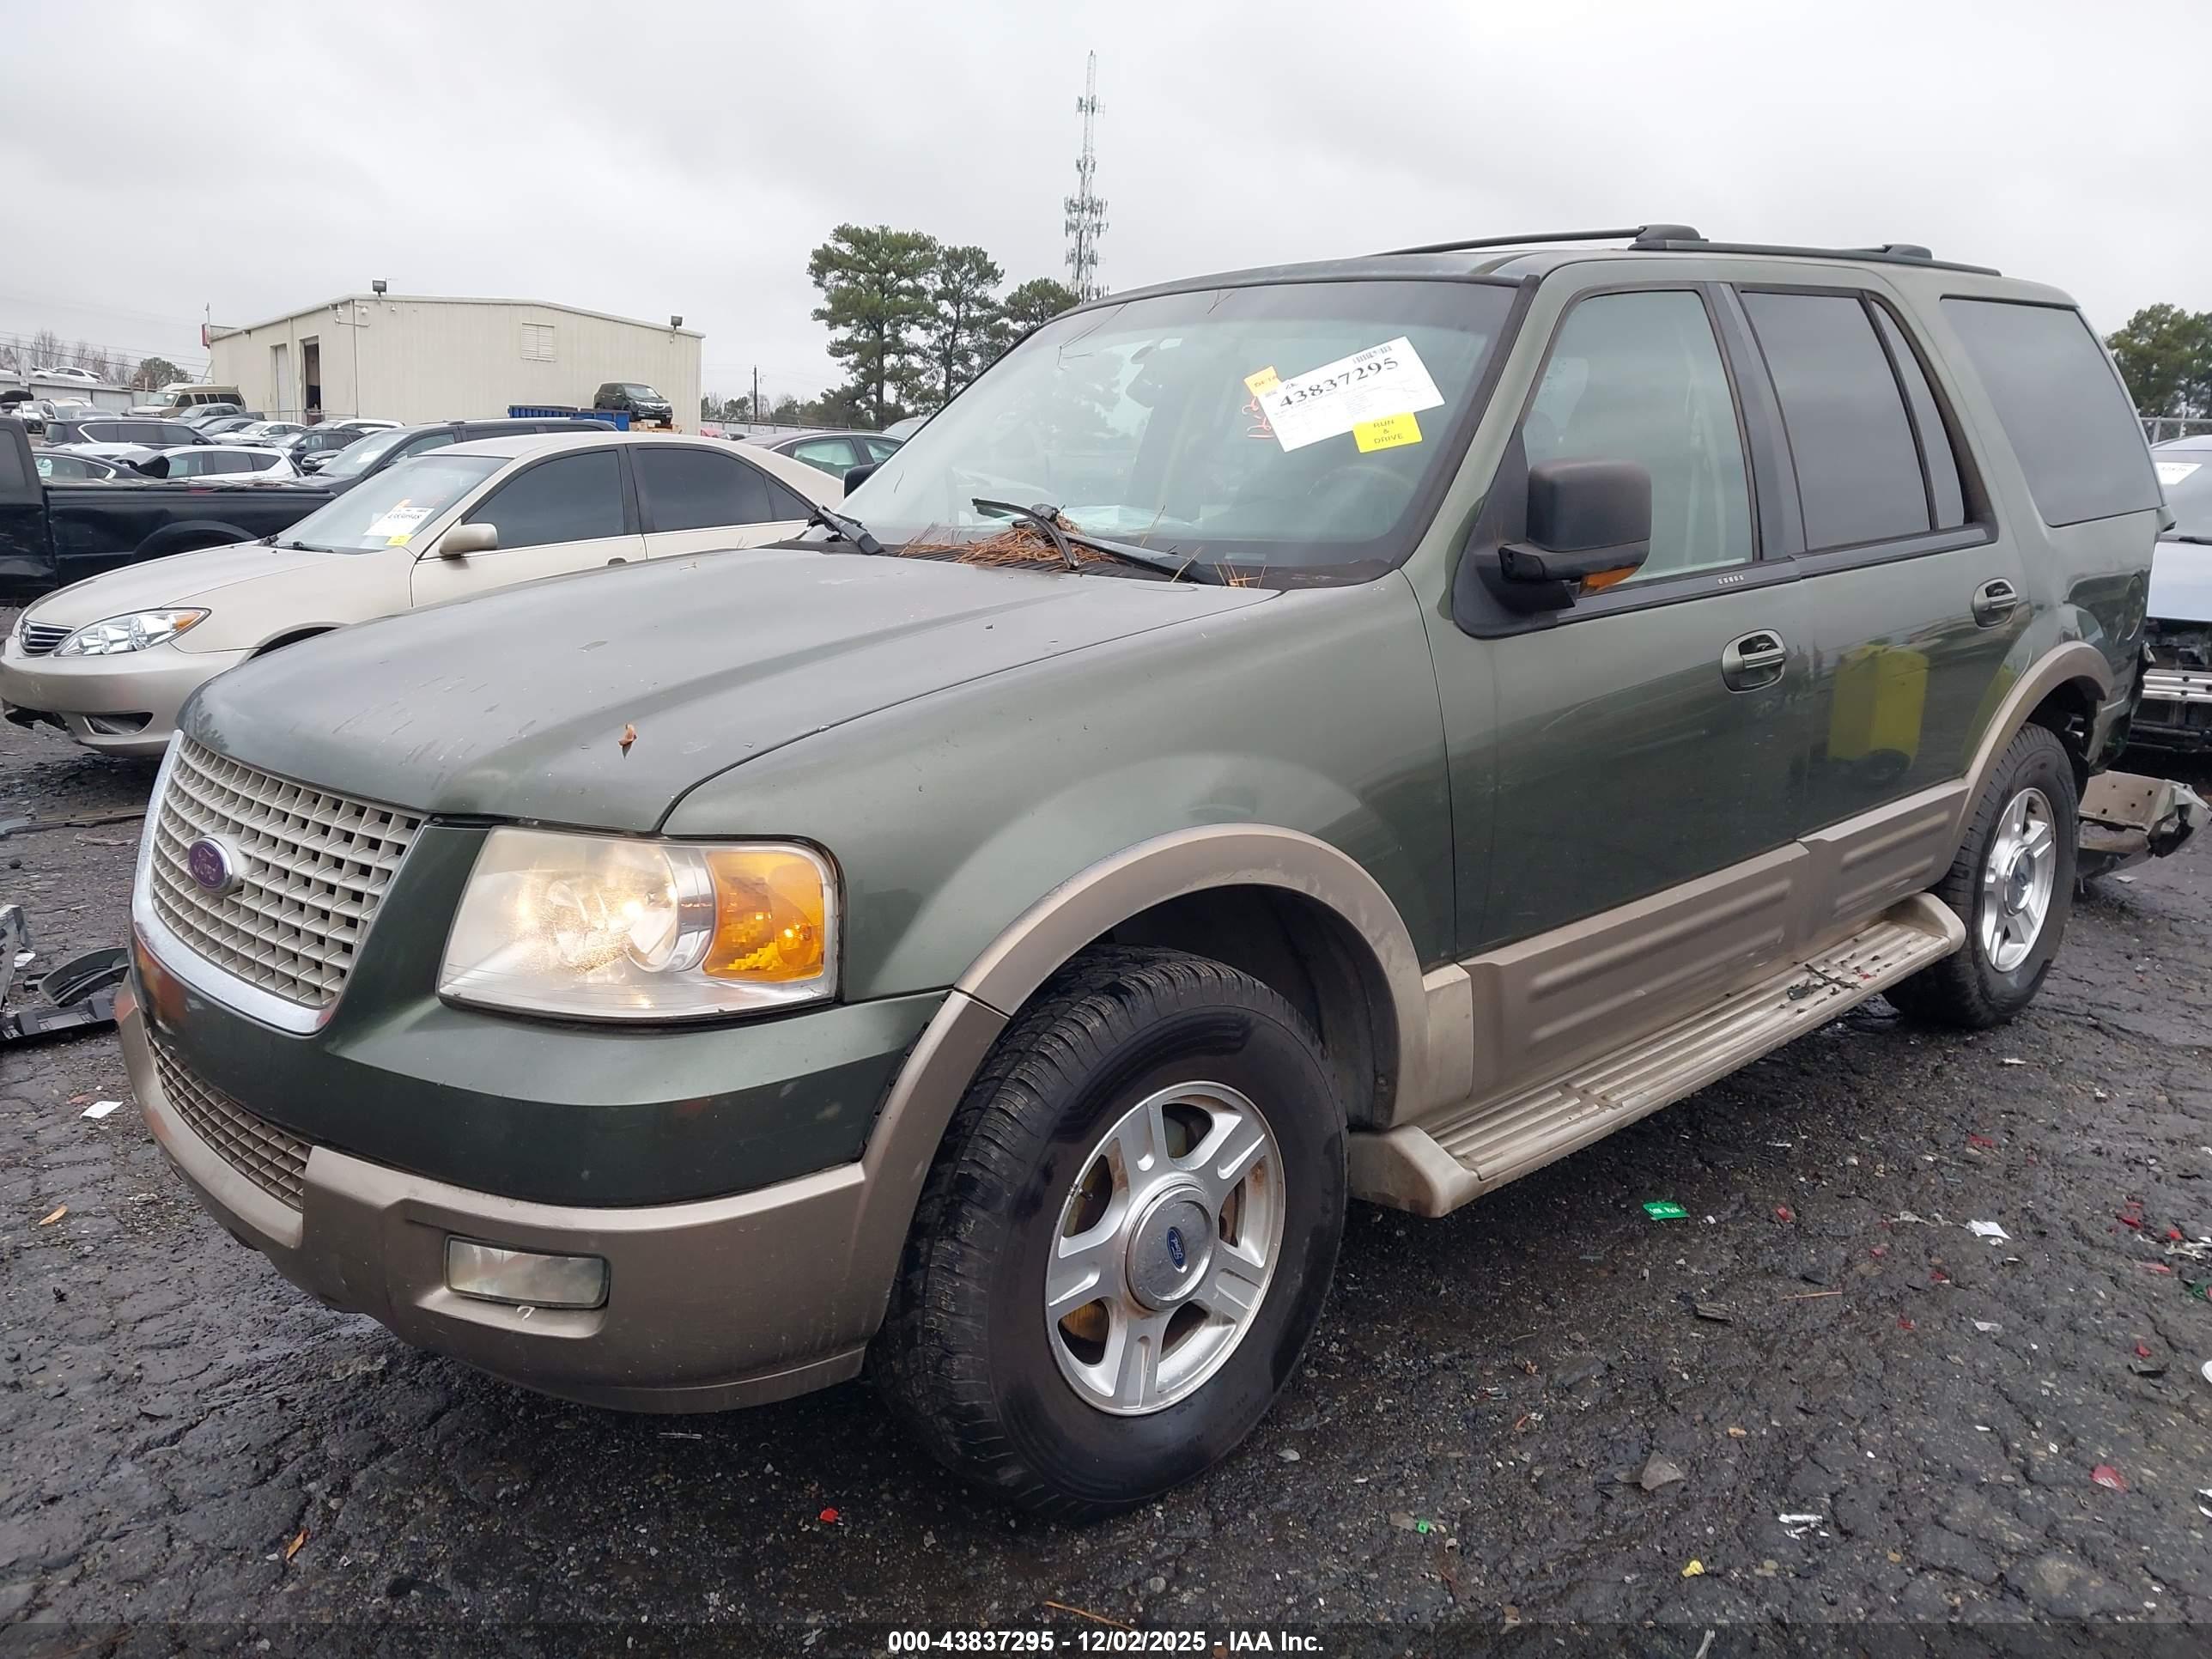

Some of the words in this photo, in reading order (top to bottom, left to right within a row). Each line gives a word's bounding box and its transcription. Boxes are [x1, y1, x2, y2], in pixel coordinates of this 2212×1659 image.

[1279, 356, 1399, 407] 43837295
[1373, 419, 1395, 428] RUN
[1374, 433, 1404, 444] DRIVE
